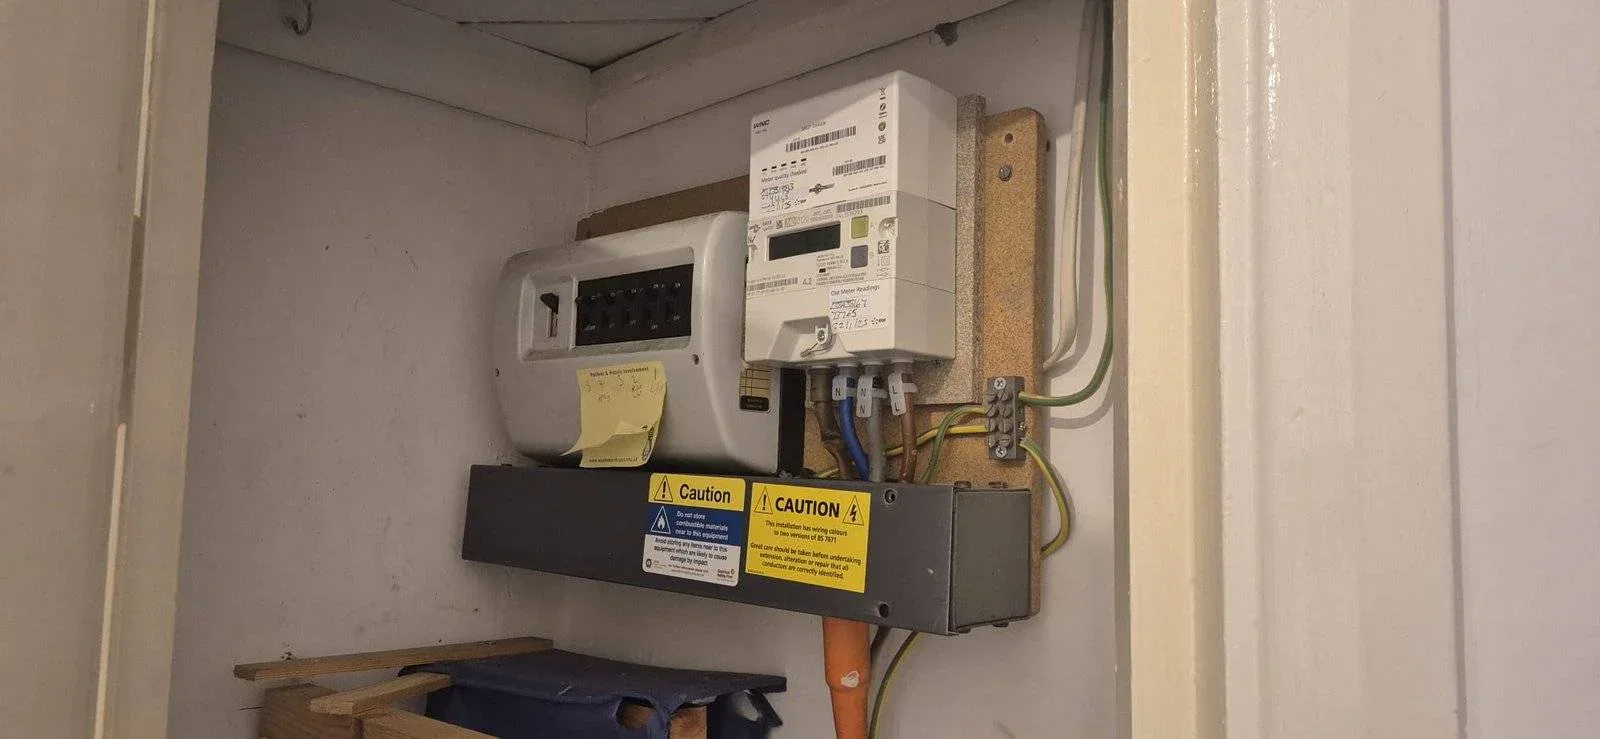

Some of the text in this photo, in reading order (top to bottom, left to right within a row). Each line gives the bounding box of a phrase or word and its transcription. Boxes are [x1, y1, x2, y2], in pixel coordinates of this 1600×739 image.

[680, 484, 730, 503] Caution
[775, 496, 840, 518] CAUTION
[676, 520, 704, 528] combustible
[776, 521, 801, 530] installation
[812, 526, 828, 535] wiring
[829, 528, 847, 536] colours
[702, 532, 728, 540] equipment
[790, 532, 810, 540] versions
[774, 545, 790, 553] should
[798, 548, 811, 557] taken
[812, 550, 829, 559] before
[830, 553, 861, 566] undertaking
[784, 556, 807, 565] alteration
[815, 560, 829, 570] repair
[831, 562, 841, 570] that
[762, 561, 787, 570] conductors
[797, 566, 818, 576] correctly
[818, 569, 844, 579] identified.
